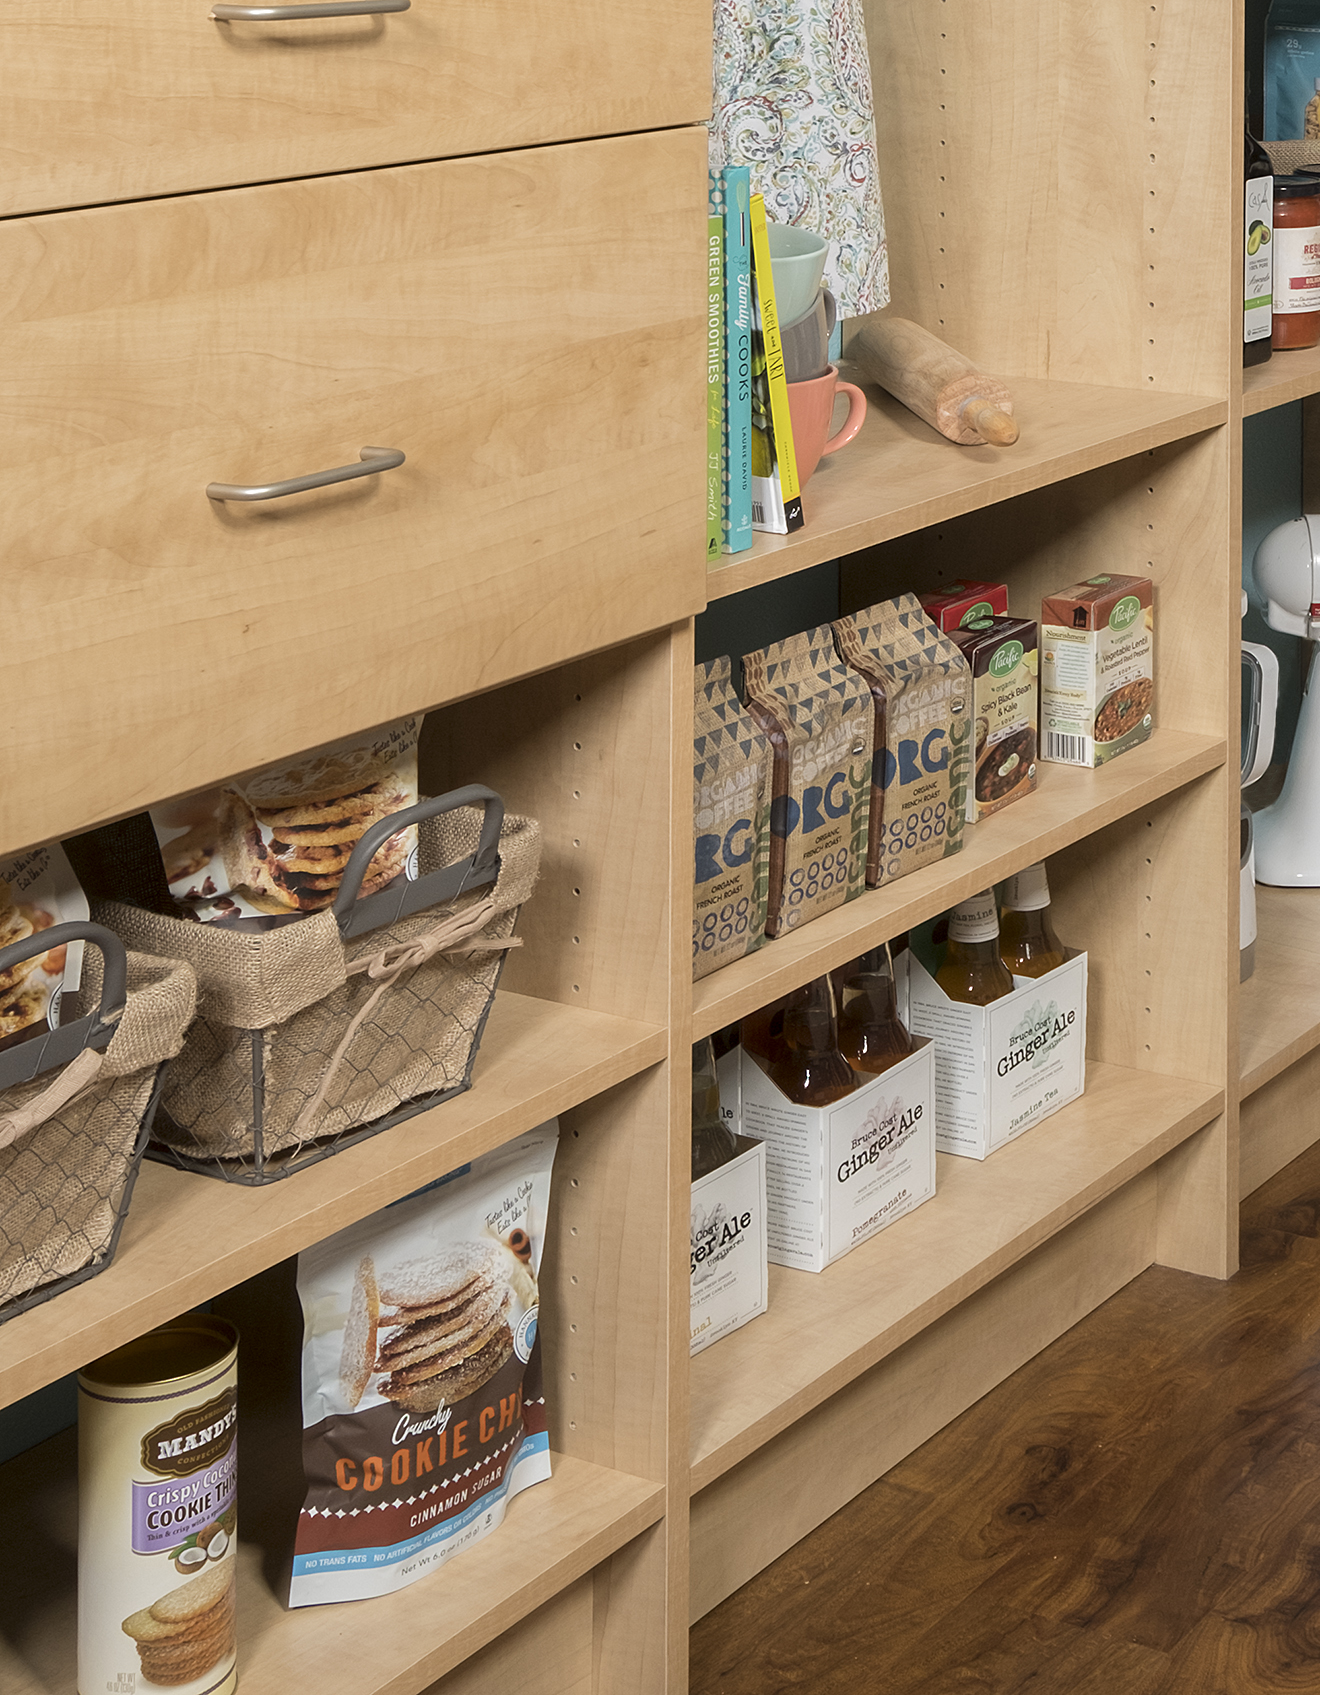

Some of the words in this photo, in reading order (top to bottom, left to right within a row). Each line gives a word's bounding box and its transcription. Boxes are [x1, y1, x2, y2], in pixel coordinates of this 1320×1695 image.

[708, 235, 720, 287] GREEN
[733, 272, 750, 332] Family
[708, 293, 720, 384] SMOOTHIES
[738, 334, 749, 402] COOKS
[707, 476, 718, 522] Smith
[1114, 603, 1137, 624] Pacific
[1046, 630, 1086, 641] Nourishment
[1102, 645, 1131, 663] Vegetable
[1131, 636, 1148, 650] Lentil
[994, 646, 1019, 671] Pacific
[1105, 657, 1123, 670] Roasted
[1123, 653, 1134, 663] Red
[891, 676, 966, 717] ORGANIC
[981, 700, 997, 714] Spicy
[997, 689, 1016, 704] Black
[1015, 683, 1032, 696] Bean
[995, 678, 1017, 692] organic
[890, 701, 947, 738] COFFEE
[997, 708, 1003, 717] &
[1003, 701, 1018, 714] Kale
[792, 717, 866, 764] ORGANIC
[871, 728, 949, 791] ORG
[901, 797, 923, 811] FRENCH
[922, 790, 941, 805] ROAST
[912, 780, 938, 796] ORGANIC
[769, 771, 851, 840] ORG
[802, 845, 824, 860] FRENCH
[824, 836, 842, 852] ROAST
[814, 826, 840, 845] ORGANIC
[696, 894, 722, 911] FRENCH
[722, 883, 744, 901] ROAST
[711, 875, 740, 893] ORGANIC
[951, 908, 994, 922] Jasmine
[997, 1027, 1050, 1078] Ginger
[1051, 1009, 1076, 1038] Ale
[1009, 1027, 1033, 1048] Bruce
[1034, 1015, 1053, 1032] Cost
[1009, 1100, 1042, 1129] Jasmine
[1044, 1087, 1059, 1102] Tea
[837, 1127, 895, 1183] Ginger
[897, 1103, 923, 1137] Ale
[850, 1127, 878, 1151] Bruce
[878, 1113, 898, 1132] Cost
[887, 1127, 918, 1155] Unfiltered
[485, 1208, 503, 1229] Tastes
[503, 1198, 515, 1213] like
[497, 1219, 511, 1235] Eats
[511, 1209, 522, 1222] like
[719, 1209, 751, 1248] Ale
[852, 1189, 907, 1239] Pomegranate
[695, 1221, 720, 1241] Cost
[707, 1235, 745, 1268] Unfiltered
[176, 1421, 194, 1434] OLD
[392, 1397, 453, 1446] Crunchy
[335, 1420, 470, 1492] COOKIE
[147, 1479, 201, 1508] Crispy
[409, 1488, 469, 1528] CINNAMON
[471, 1466, 503, 1495] SUGAR
[147, 1491, 213, 1531] COOKIE
[147, 1530, 163, 1542] Thin
[164, 1528, 172, 1538] &
[172, 1521, 191, 1536] crisp
[191, 1513, 207, 1528] with
[373, 1553, 386, 1562] NO
[386, 1539, 423, 1560] ARTIFICIAL
[423, 1524, 453, 1546] FLAVORS
[453, 1519, 462, 1530] OR
[462, 1502, 482, 1524] COLORS
[305, 1560, 318, 1569] NO
[319, 1556, 346, 1566] TRANS
[347, 1554, 367, 1564] FATS
[401, 1563, 417, 1576] Net
[418, 1555, 431, 1568] Wt
[432, 1548, 447, 1561] 6.0
[447, 1544, 456, 1553] oz
[456, 1531, 472, 1548] (170
